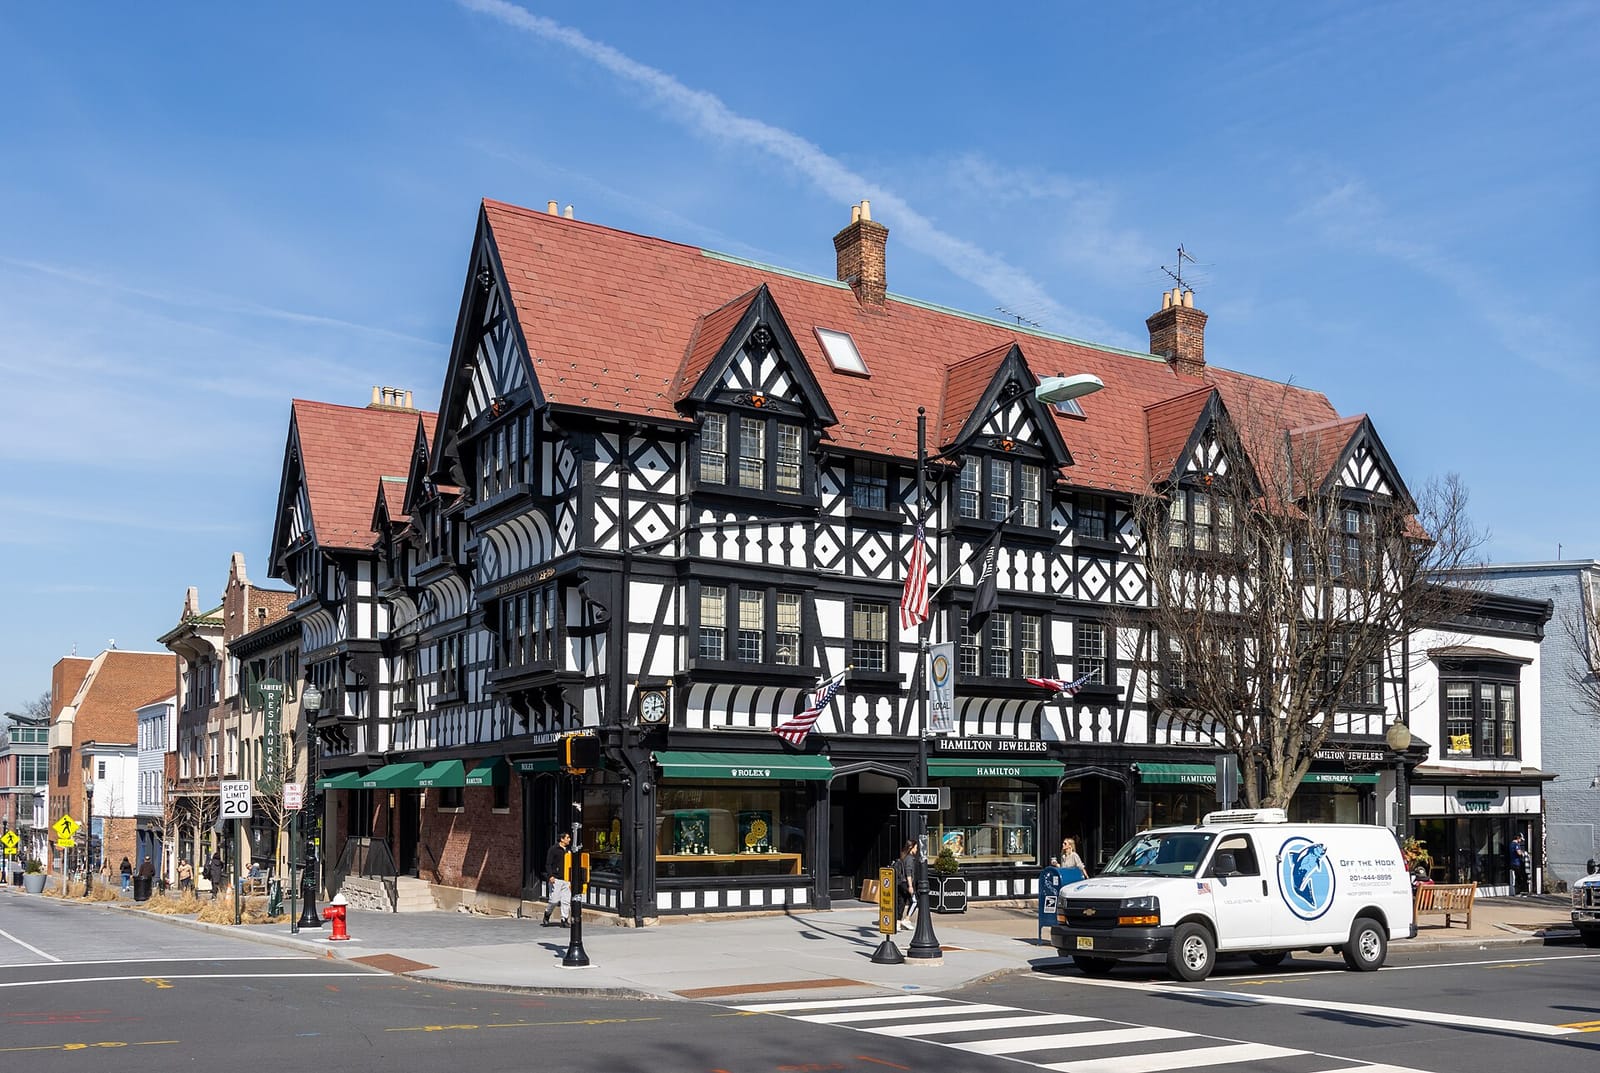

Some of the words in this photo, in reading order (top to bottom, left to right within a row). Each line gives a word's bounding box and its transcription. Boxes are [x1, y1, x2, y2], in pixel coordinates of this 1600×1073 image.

[933, 702, 951, 711] LOCAL
[267, 692, 275, 782] RESTAURANT
[940, 739, 993, 751] HAMILTON
[997, 741, 1048, 752] JEWELERS
[1313, 750, 1345, 760] AMILTON
[1348, 751, 1384, 761] JEWELERS
[738, 769, 764, 777] ROLEX
[977, 767, 1020, 776] HAMILTON
[1181, 775, 1216, 783] HAMILTON
[223, 784, 249, 792] SPEED
[910, 794, 921, 804] ONE
[923, 795, 936, 804] WAY
[224, 800, 249, 814] 20
